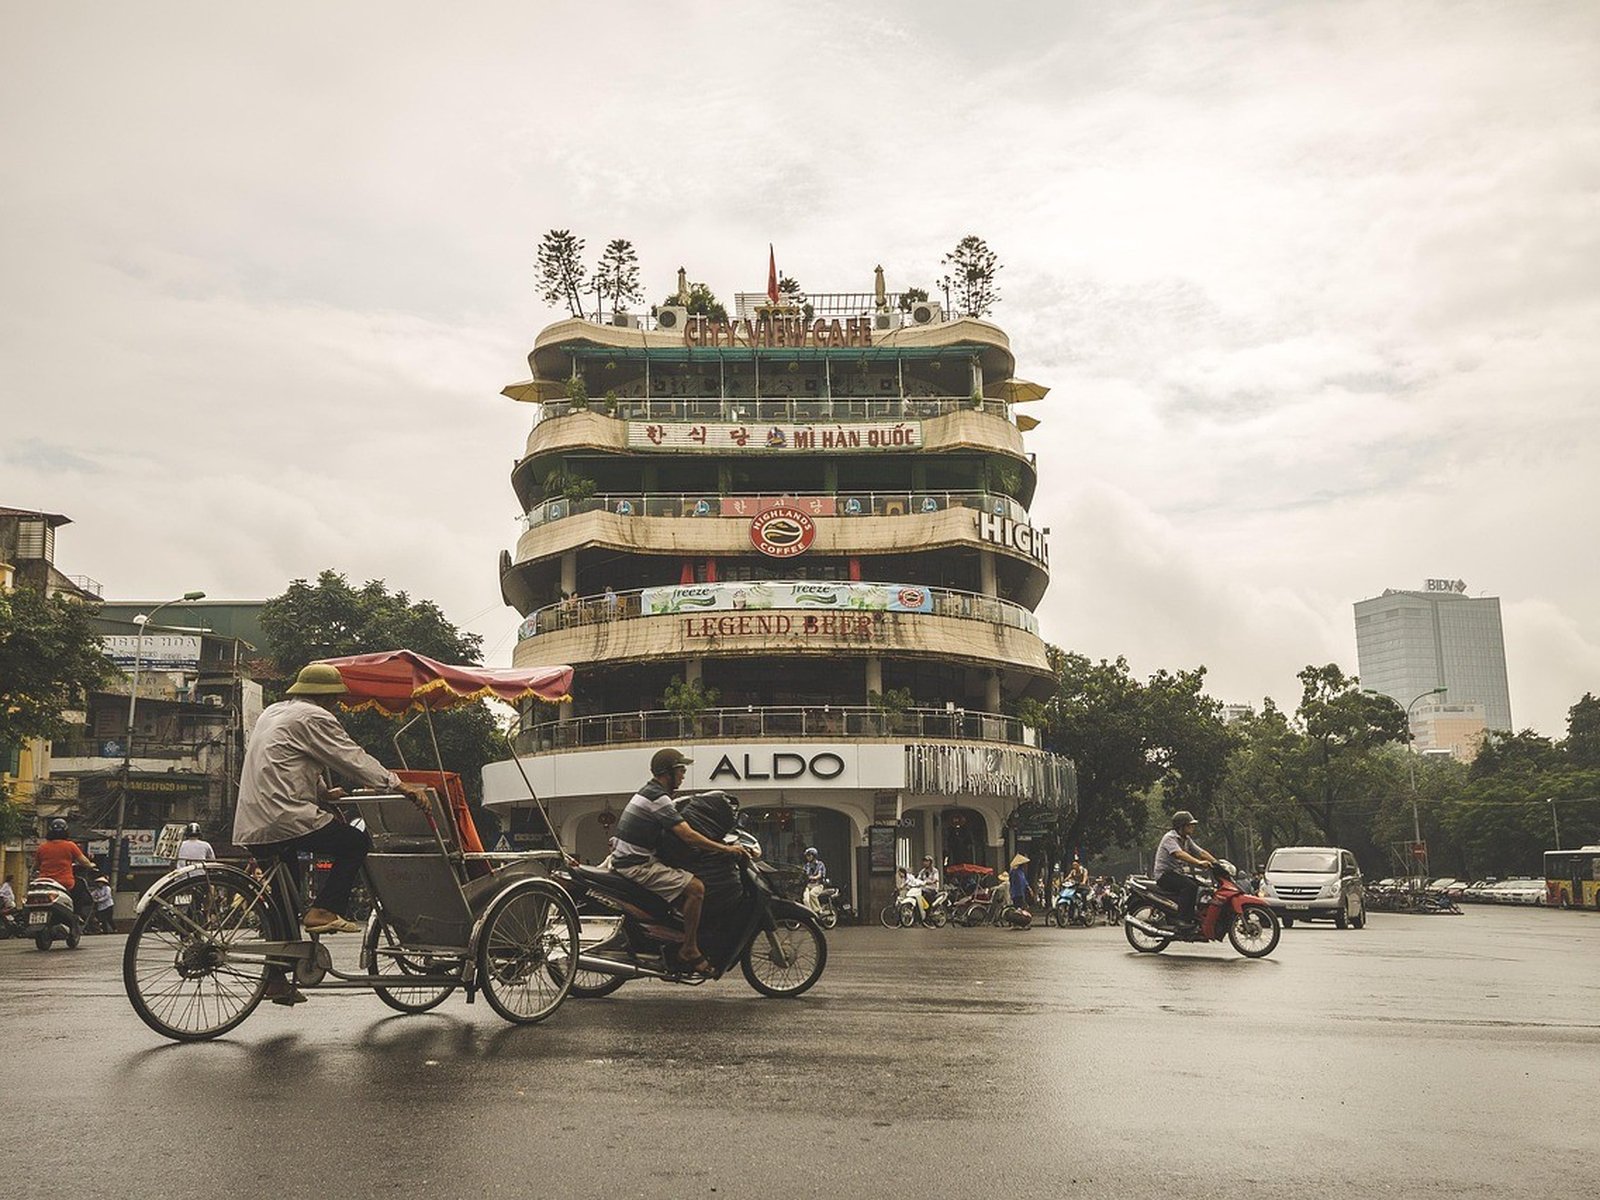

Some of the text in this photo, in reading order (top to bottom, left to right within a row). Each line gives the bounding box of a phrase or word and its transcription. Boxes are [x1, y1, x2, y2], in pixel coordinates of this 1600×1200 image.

[684, 317, 739, 348] CITY
[746, 318, 808, 348] VIEW
[794, 423, 915, 448] MÌ HÀN QUỐC
[753, 510, 813, 530] HIGHLANDS
[760, 541, 806, 555] COFFEE
[671, 588, 711, 601] freeze
[790, 584, 831, 596] freeze
[1427, 579, 1455, 591] BIDV
[685, 615, 873, 638] LEGEND BEER
[709, 753, 845, 780] ALDO
